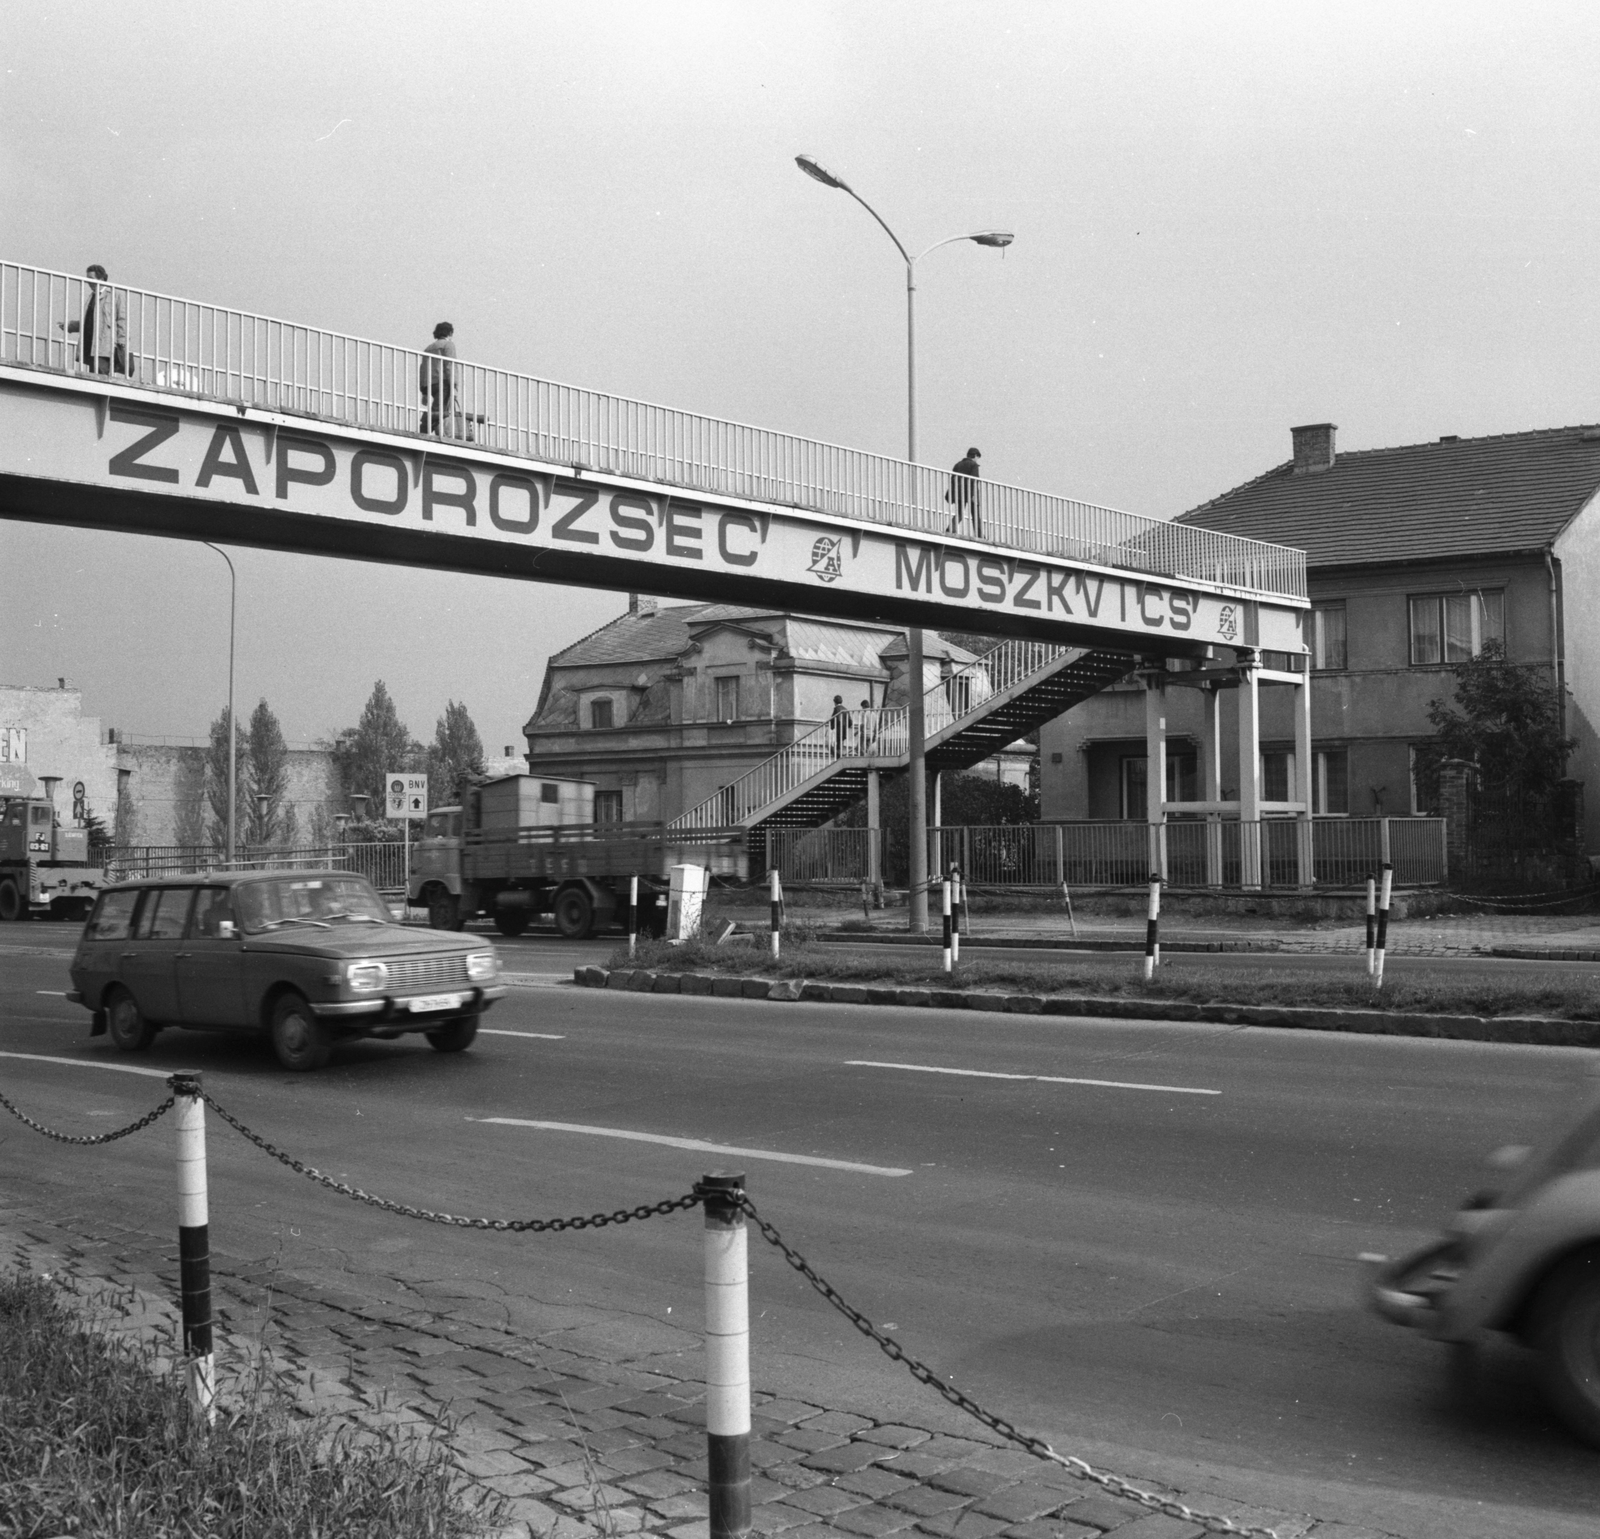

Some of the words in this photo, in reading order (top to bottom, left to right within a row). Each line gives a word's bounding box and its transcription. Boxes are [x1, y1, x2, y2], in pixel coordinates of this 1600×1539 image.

[108, 404, 760, 567] ZAPOROZSEC
[894, 542, 1191, 632] MOSZKVICS
[0, 778, 21, 791] king
[408, 780, 425, 789] BNV
[35, 833, 45, 841] FJ
